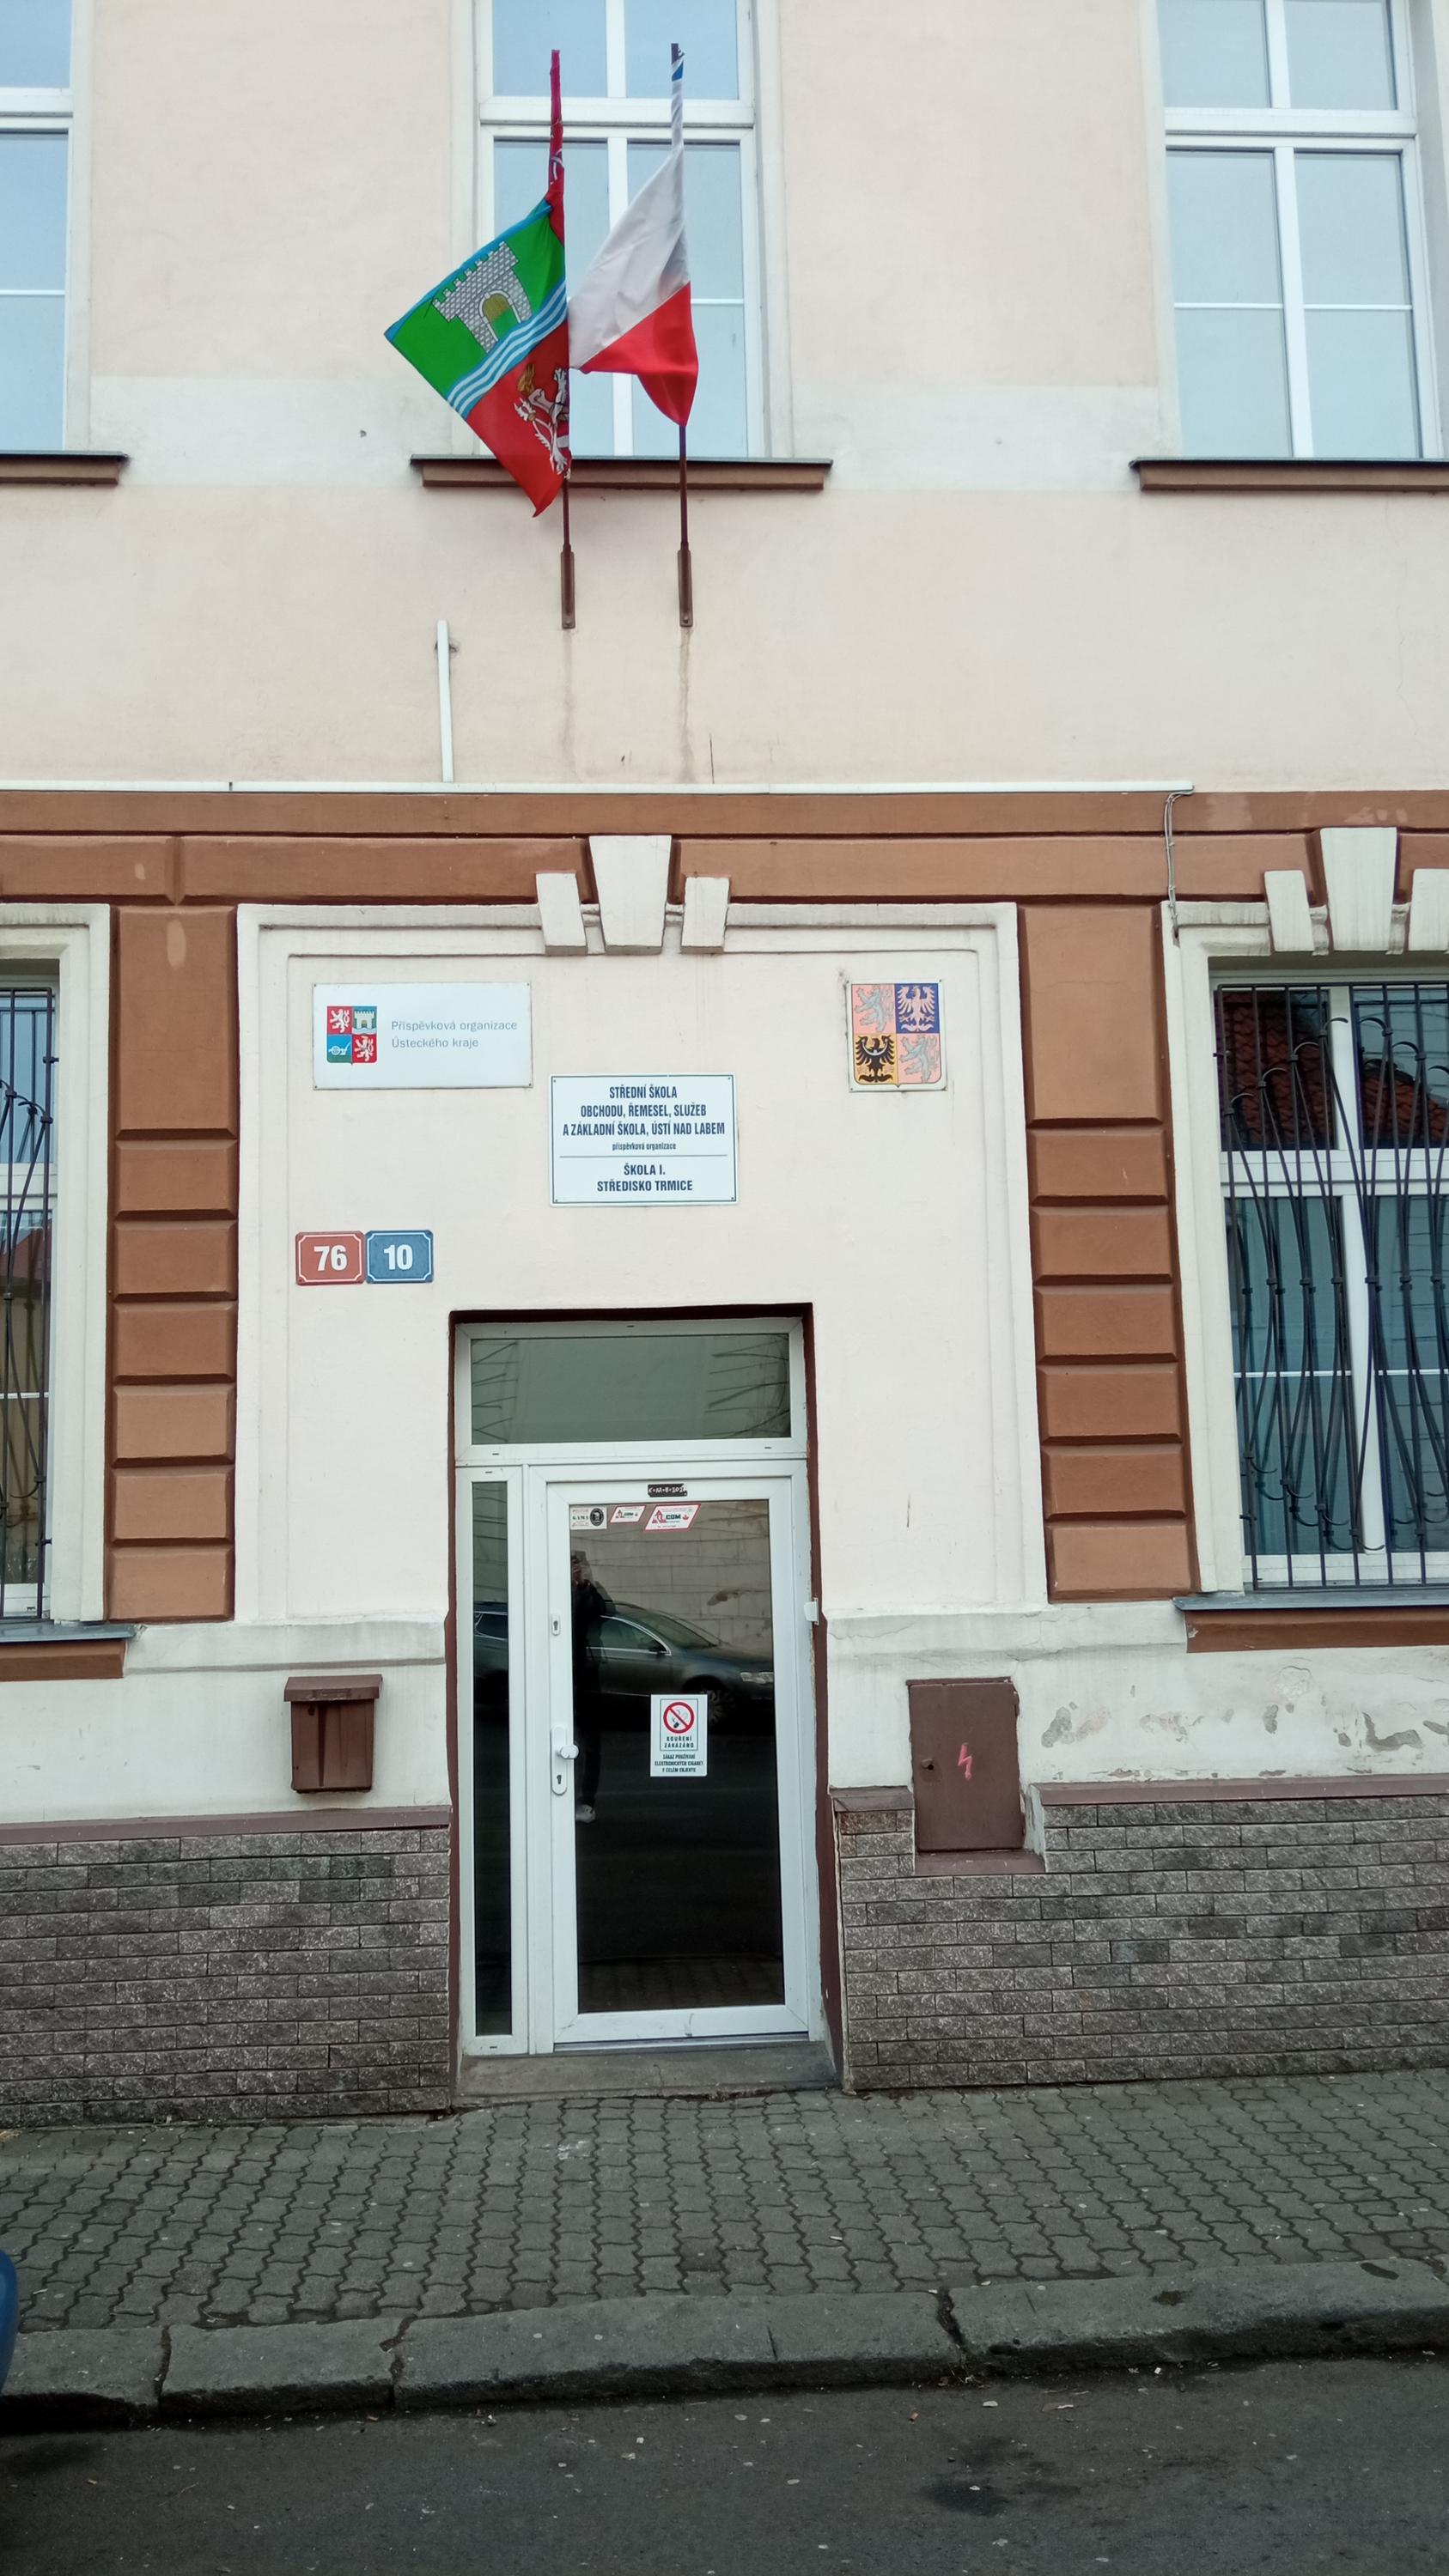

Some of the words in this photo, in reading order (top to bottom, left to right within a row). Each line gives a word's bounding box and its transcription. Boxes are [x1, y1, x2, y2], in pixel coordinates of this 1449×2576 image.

[391, 1020, 456, 1032] Příspěvková
[460, 1020, 518, 1032] organizace
[392, 1034, 448, 1048] Ústeckého
[453, 1037, 479, 1049] kraje
[609, 1084, 647, 1099] STŘEDNÍ
[648, 1084, 678, 1099] ŠKOLA
[581, 1104, 625, 1118] OBCHODU,
[628, 1103, 672, 1118] ŘEMESEL,
[673, 1102, 707, 1116] SLUŽEB
[563, 1124, 569, 1136] A
[571, 1121, 615, 1136] ZÁKLADNÍ
[618, 1121, 648, 1137] ŠKOLA,
[651, 1120, 671, 1135] ÚSTÍ
[673, 1122, 692, 1135] NAD
[694, 1121, 725, 1135] LABEM
[612, 1141, 645, 1151] příspěvková
[646, 1142, 677, 1151] organizace
[624, 1162, 656, 1176] ŠKOLA
[659, 1164, 666, 1176] I.
[597, 1178, 652, 1192] STŘEDISKO
[654, 1180, 693, 1191] TRMICE
[314, 1244, 348, 1272] 76
[383, 1244, 413, 1271] 10
